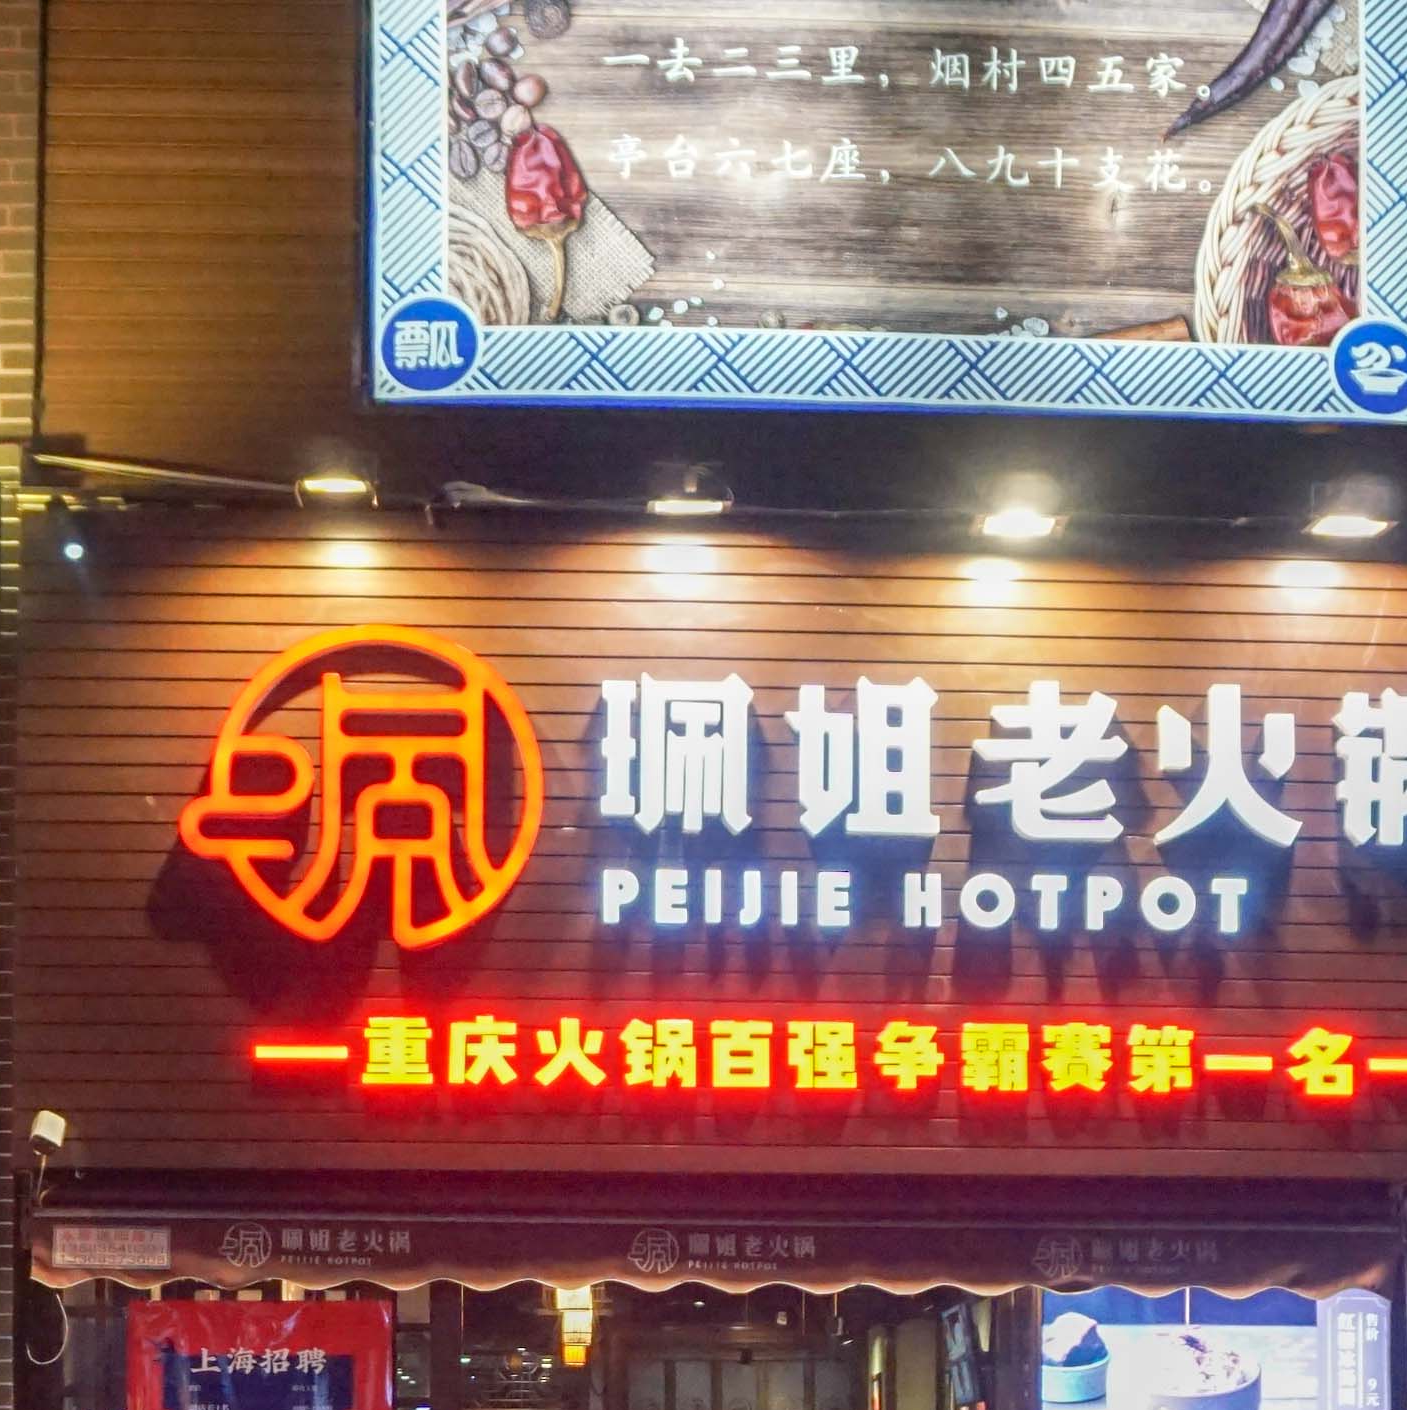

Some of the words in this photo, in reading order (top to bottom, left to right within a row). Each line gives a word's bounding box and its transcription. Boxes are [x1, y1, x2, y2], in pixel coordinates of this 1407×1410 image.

[602, 36, 1211, 99] 一去二三里，烟村四五家。
[608, 134, 1212, 193] 亭台六七座，八九十支花。
[602, 868, 852, 928] PEIJIE
[903, 872, 1249, 933] HOTPOT
[190, 1346, 328, 1375] 上海招聘
